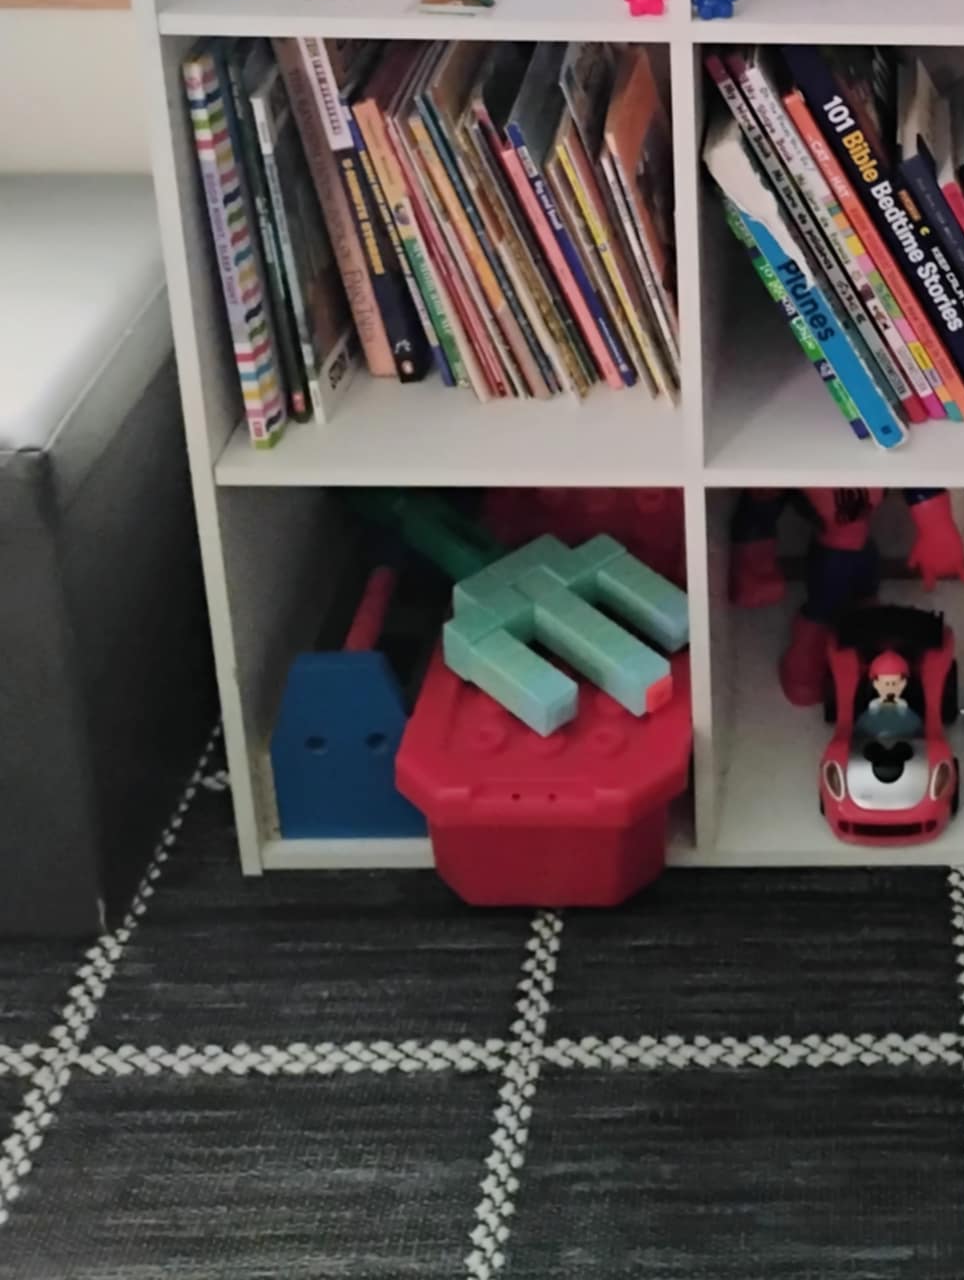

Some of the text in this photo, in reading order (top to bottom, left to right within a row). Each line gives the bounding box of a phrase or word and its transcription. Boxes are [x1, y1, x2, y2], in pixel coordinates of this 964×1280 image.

[822, 95, 856, 133] 101
[841, 129, 880, 183] Bible
[870, 180, 925, 264] Bedtime
[916, 261, 964, 333] Stories
[777, 258, 835, 342] Planes
